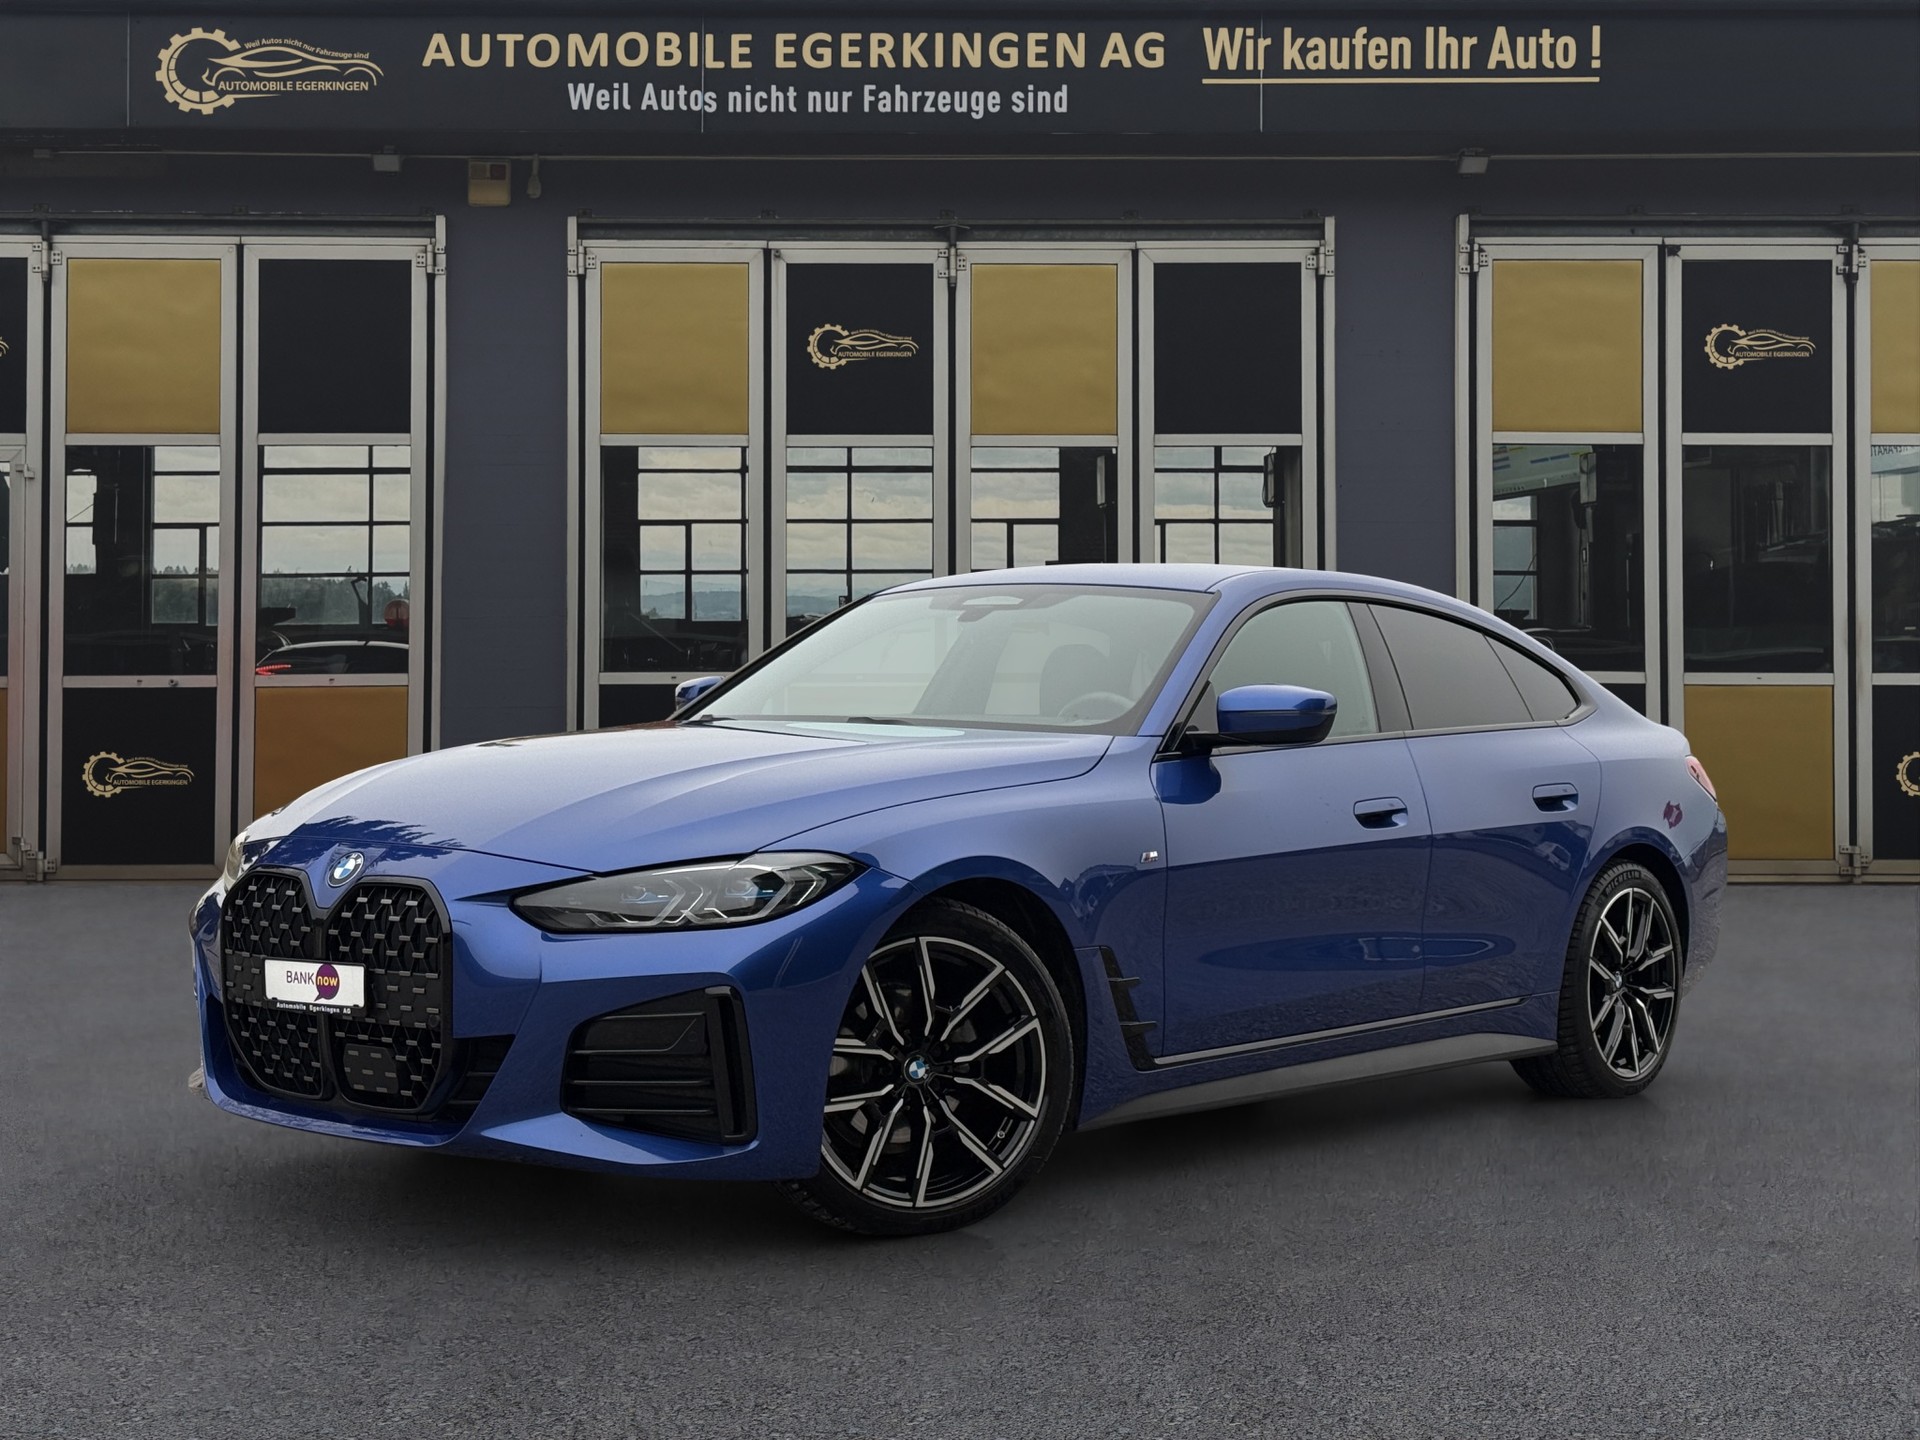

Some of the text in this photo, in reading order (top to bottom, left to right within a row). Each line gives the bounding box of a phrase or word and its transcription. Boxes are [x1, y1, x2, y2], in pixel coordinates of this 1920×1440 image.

[243, 37, 370, 60] Weil Autos nicht nur Fahrzeuge sind
[421, 31, 1166, 69] AUTOMOBILE EGERKINGEN AG
[1202, 24, 1602, 71] Wir kaufen Ihr Auto !
[218, 81, 369, 91] AUTOMOBILE EGERKINGEN
[567, 82, 1068, 120] Weil Autos nicht nur Fahrzeuge sind
[1604, 870, 1641, 896] MICHELIN
[286, 970, 338, 987] BANK now
[276, 1002, 307, 1011] Automobile
[309, 1004, 340, 1014] Egerkingen
